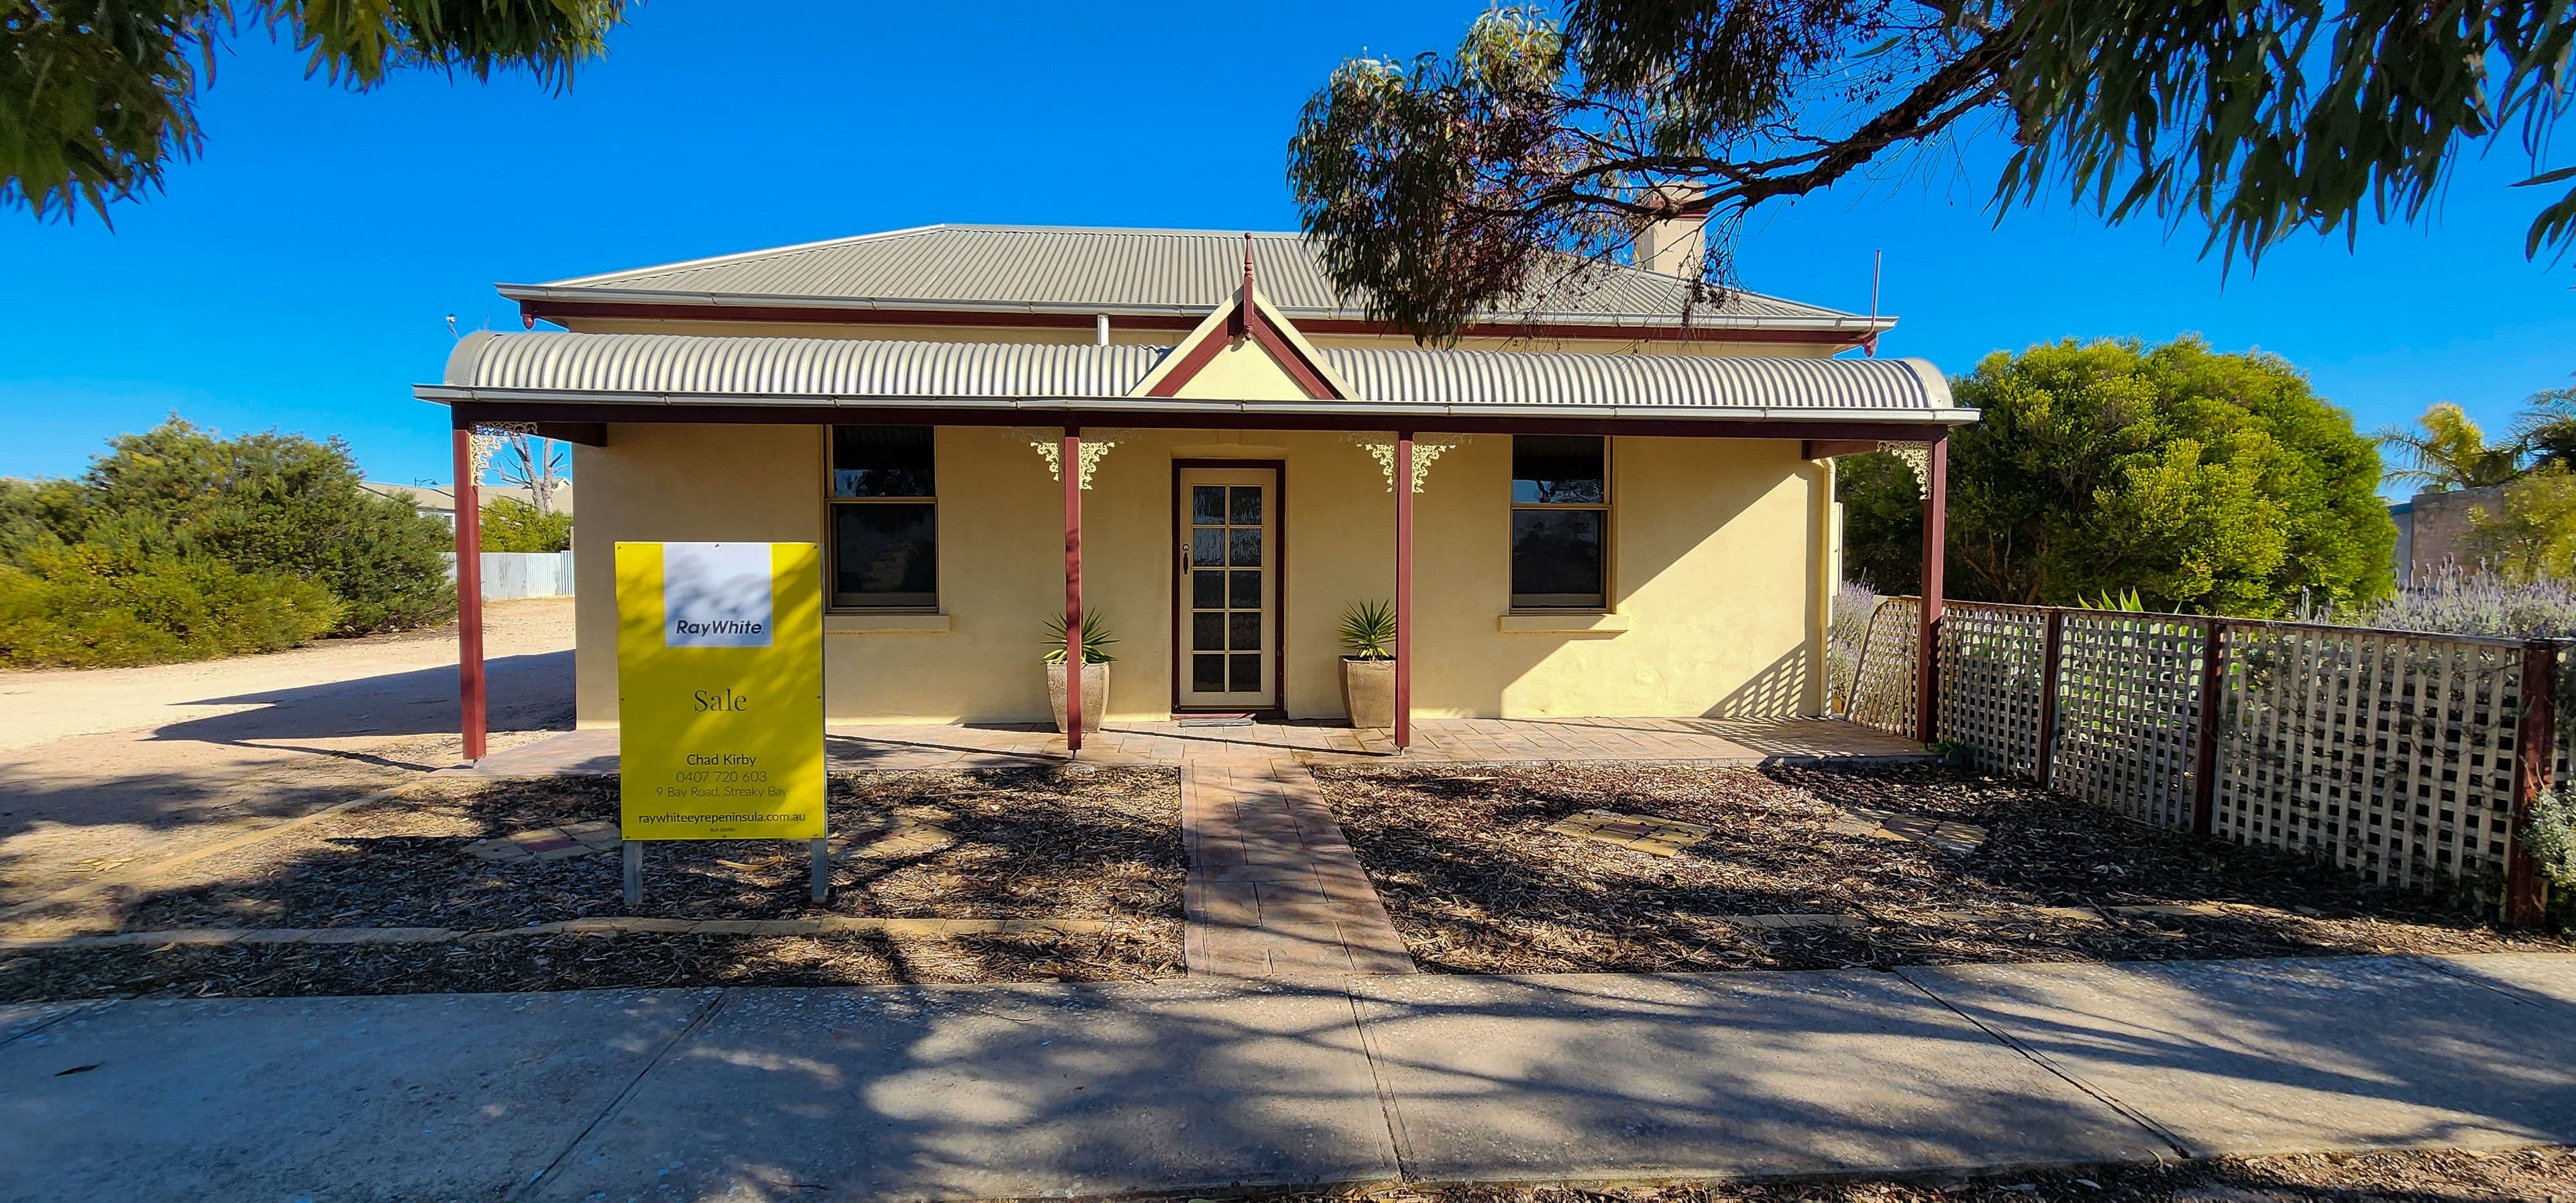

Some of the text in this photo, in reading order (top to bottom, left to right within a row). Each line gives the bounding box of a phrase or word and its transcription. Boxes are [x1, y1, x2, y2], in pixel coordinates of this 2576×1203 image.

[694, 688, 747, 713] Sale
[686, 753, 757, 768] Chad Kirby
[676, 771, 767, 782] 0407 720 603
[656, 787, 663, 797] 9
[667, 787, 687, 798] Bay
[724, 786, 763, 798] Streaky
[768, 786, 788, 797] Bay
[639, 811, 806, 825] raywhiteeyrepeninsula.com.au
